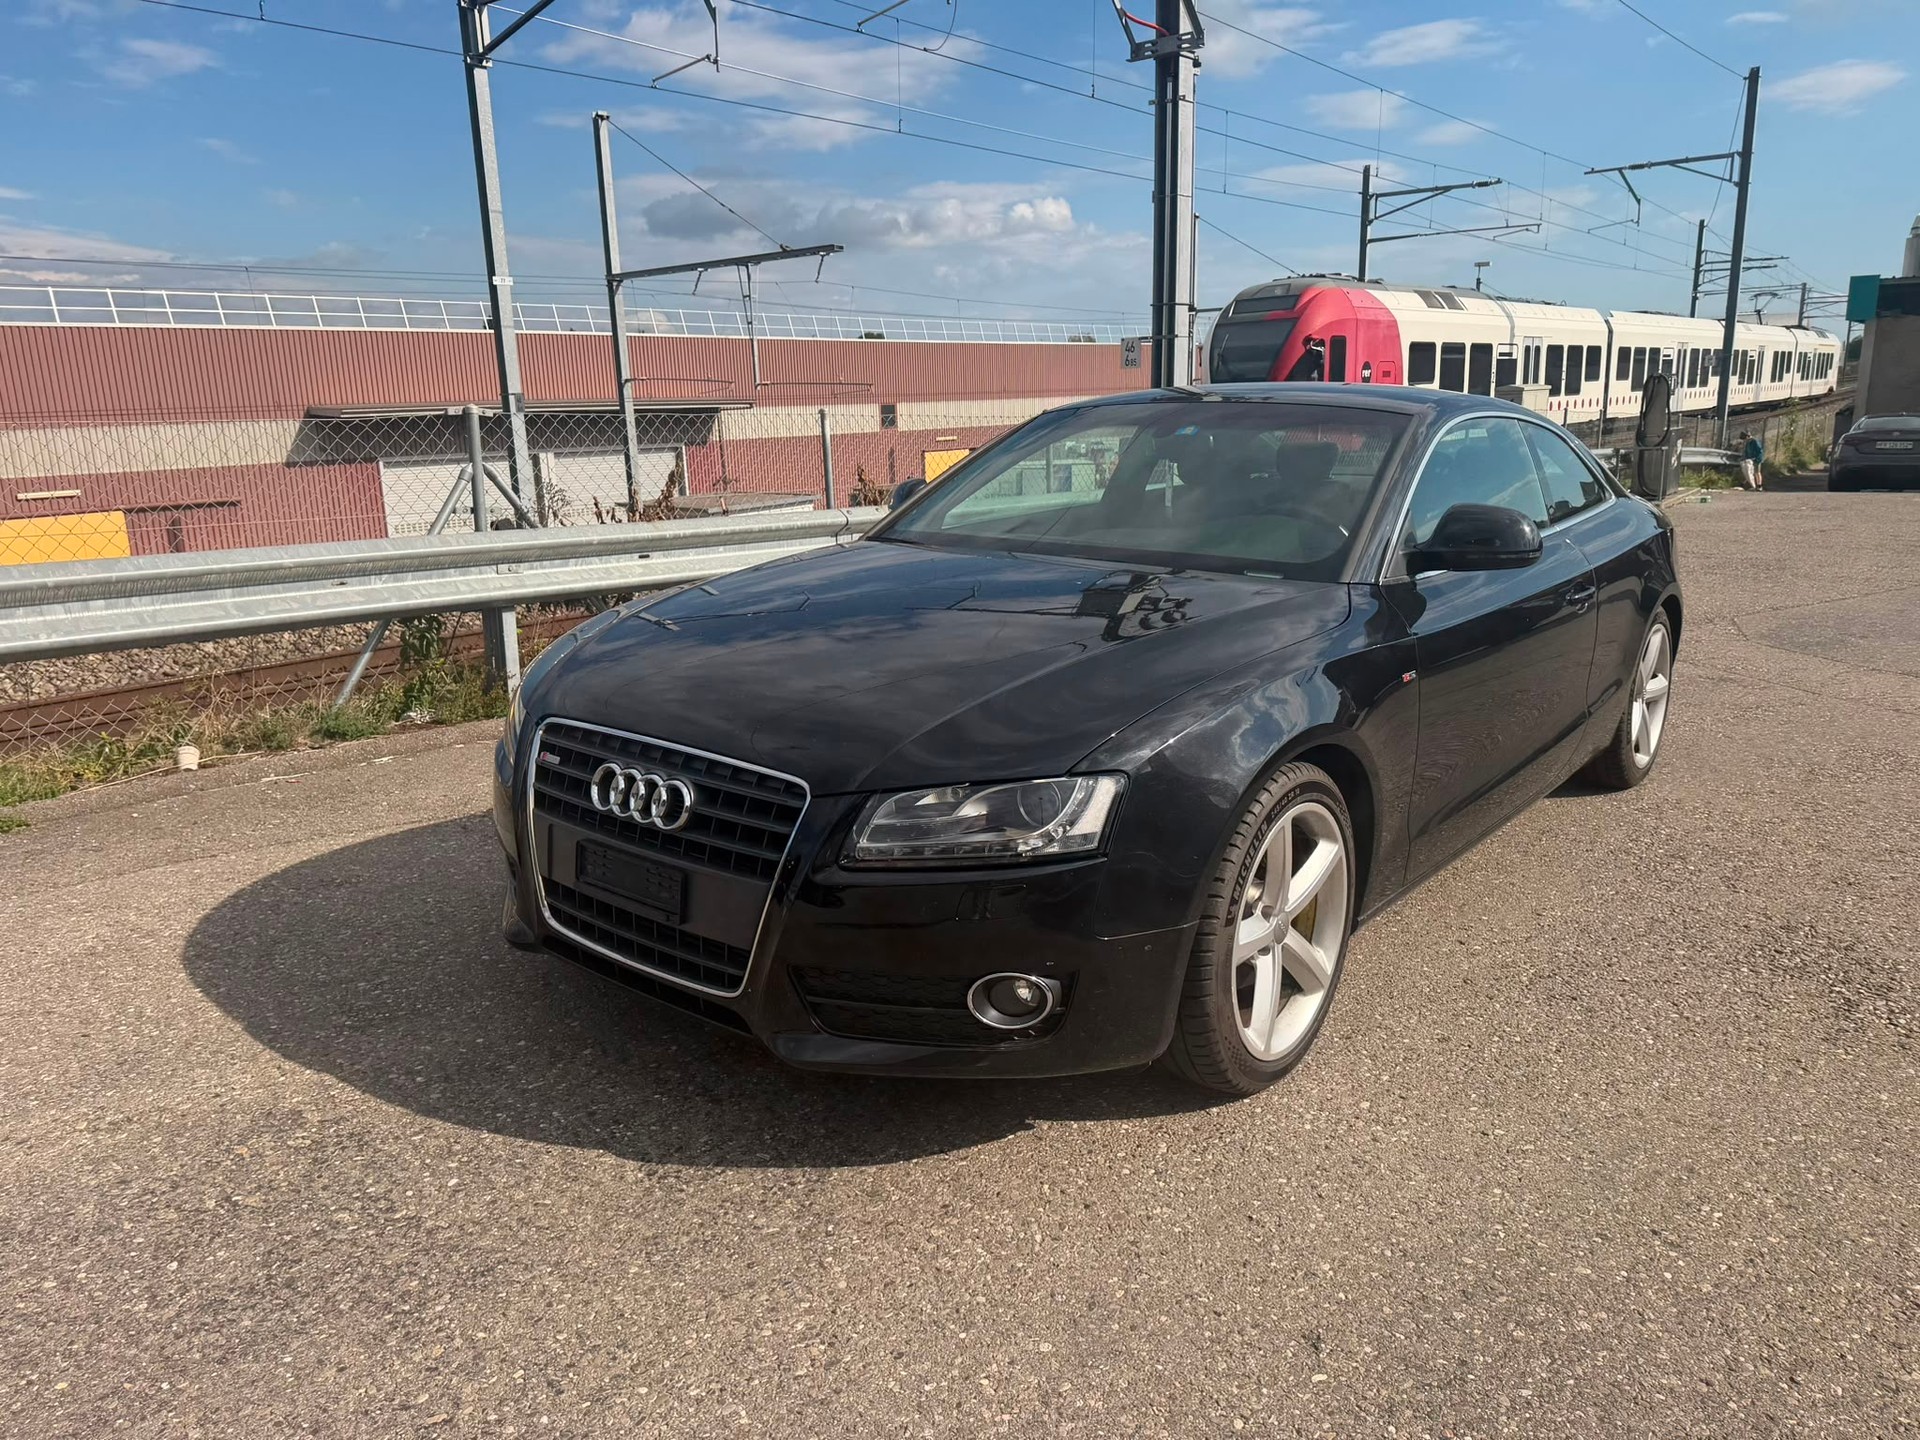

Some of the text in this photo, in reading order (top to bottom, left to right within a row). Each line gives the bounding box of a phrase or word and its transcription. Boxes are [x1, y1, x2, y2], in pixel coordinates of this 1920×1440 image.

[1125, 341, 1136, 353] 46
[1361, 369, 1371, 378] rer
[1232, 820, 1268, 901] MICHELIN
